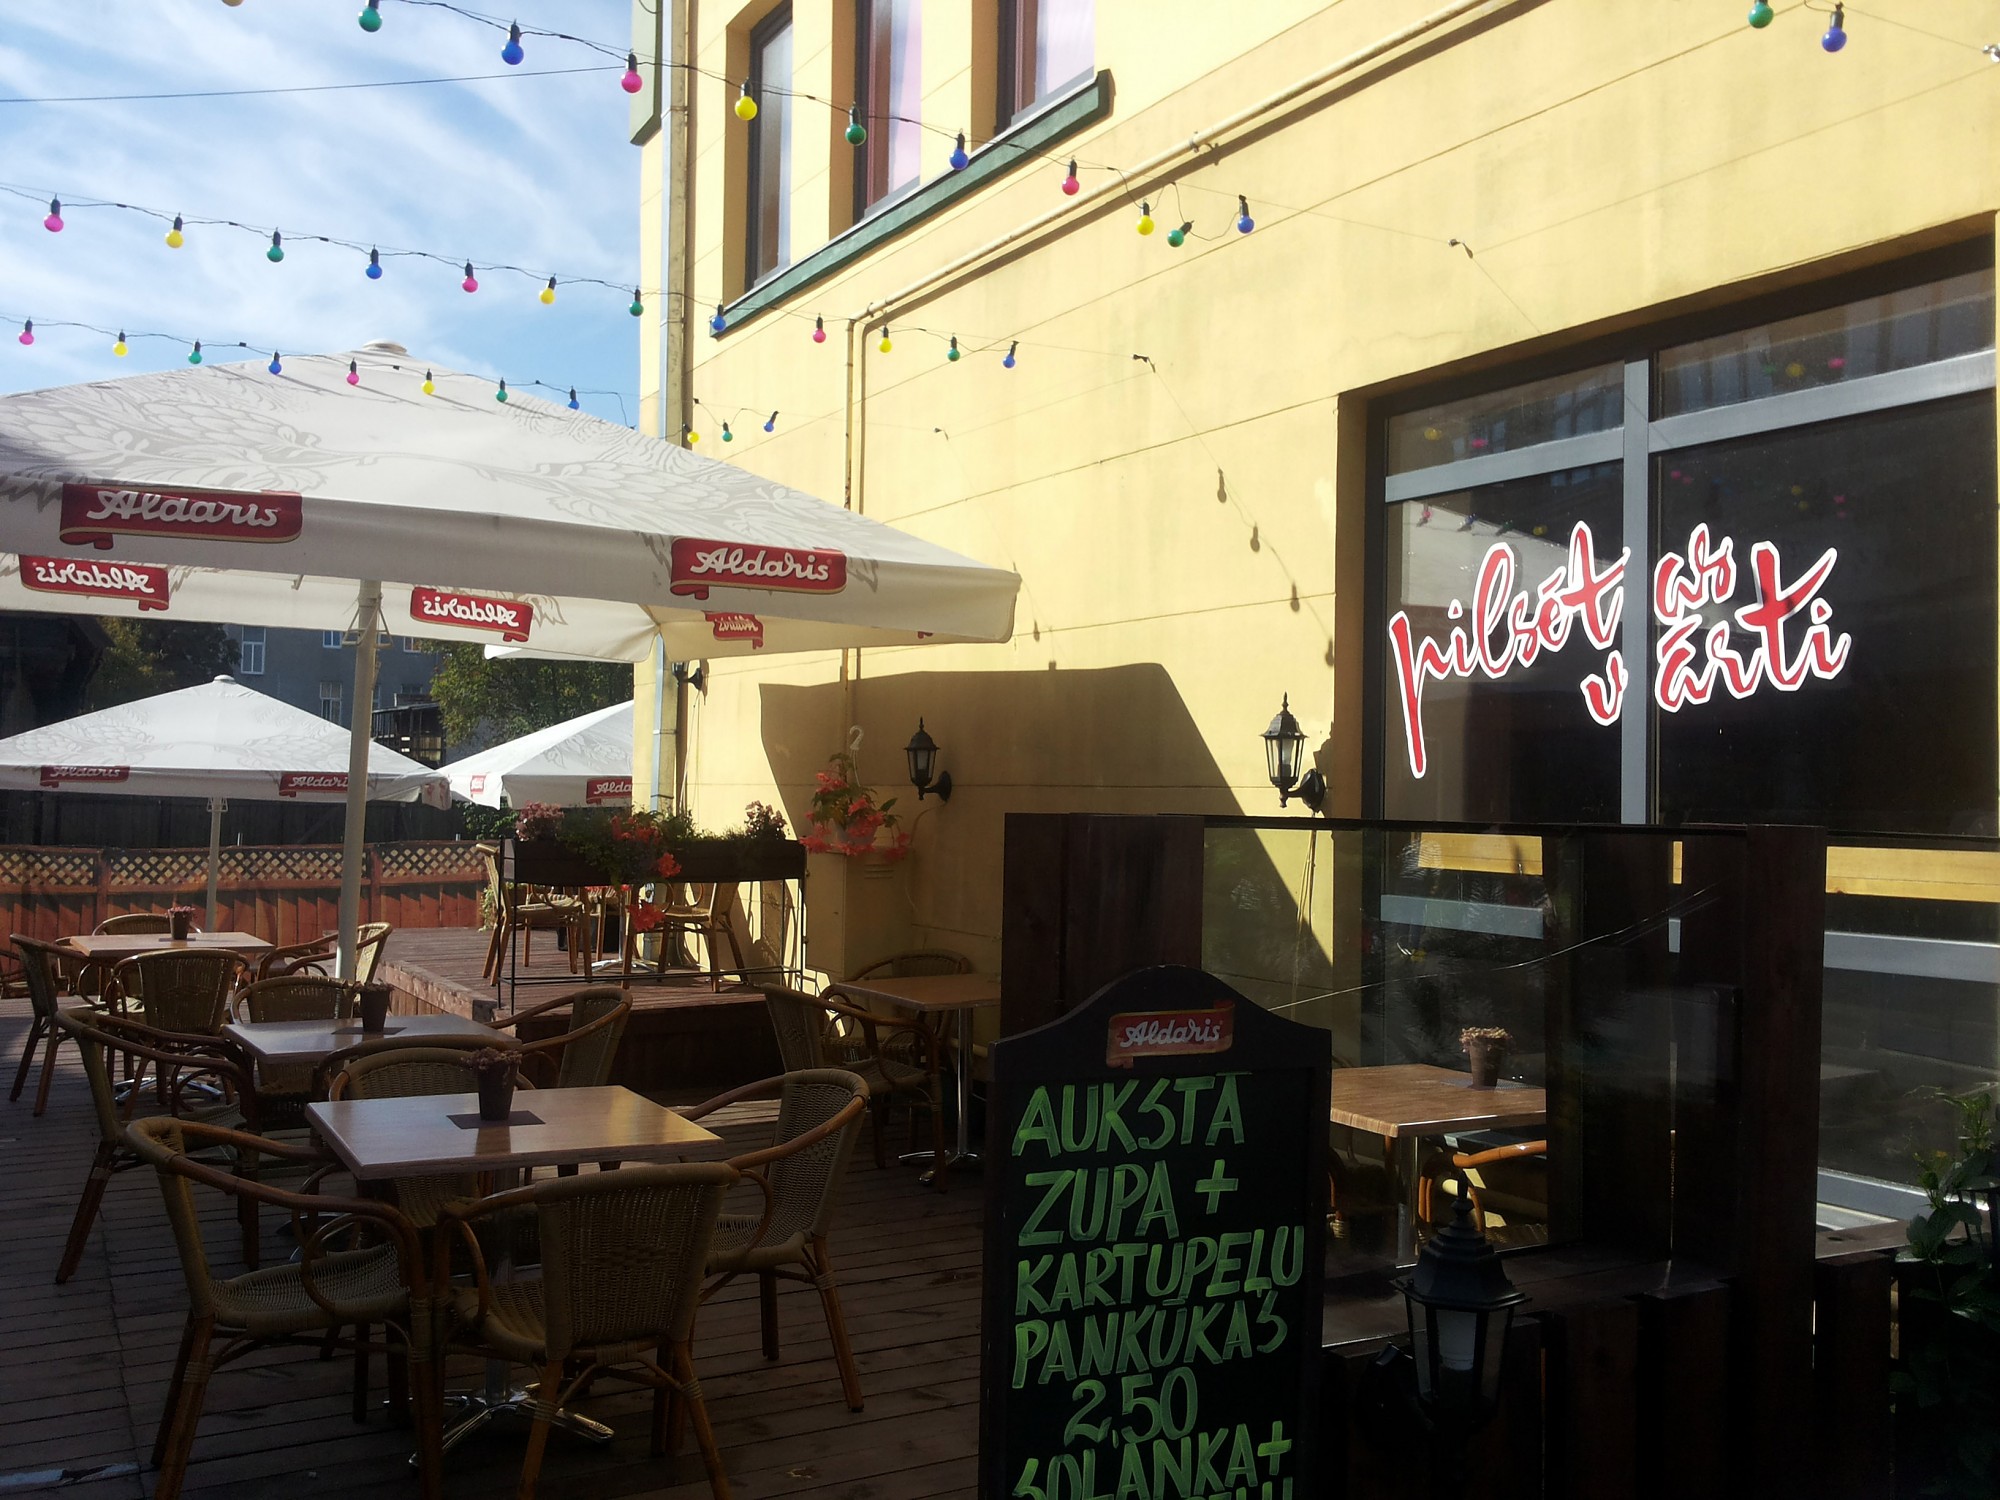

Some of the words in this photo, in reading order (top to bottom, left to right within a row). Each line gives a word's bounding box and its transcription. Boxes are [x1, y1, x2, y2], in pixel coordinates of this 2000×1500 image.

[86, 490, 282, 529] Aldaris
[690, 547, 829, 582] Aldaris
[288, 775, 349, 788] Aldari
[1120, 1019, 1222, 1049] Aldaris
[1018, 1161, 1180, 1247] ZUPA
[1195, 1159, 1239, 1215] +
[1064, 1367, 1198, 1448] 2,50
